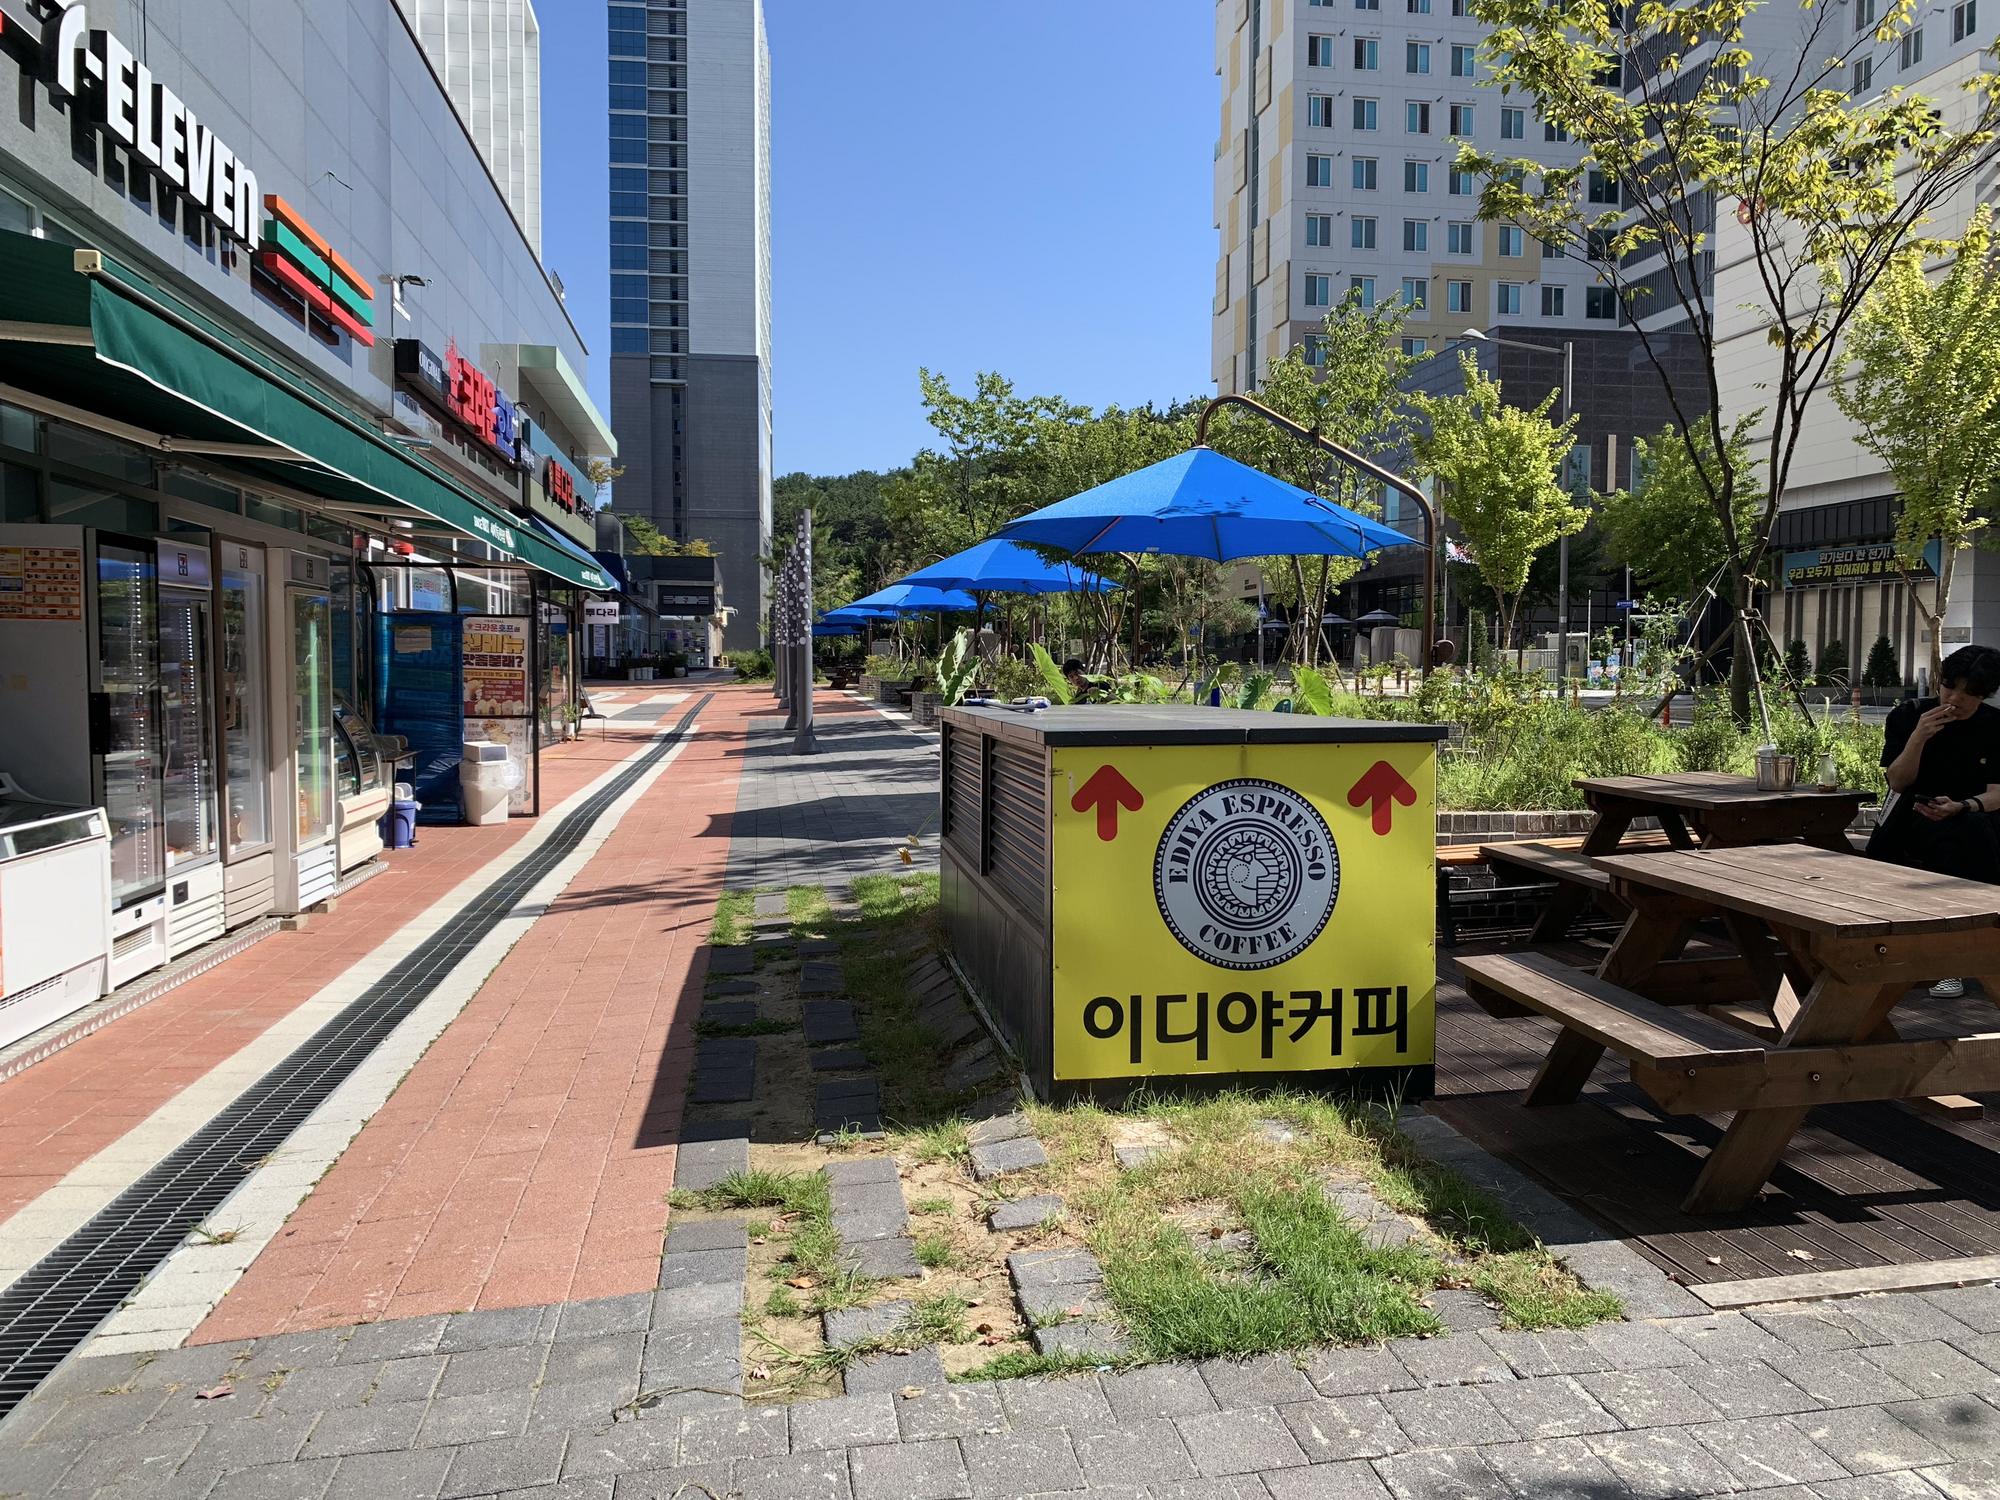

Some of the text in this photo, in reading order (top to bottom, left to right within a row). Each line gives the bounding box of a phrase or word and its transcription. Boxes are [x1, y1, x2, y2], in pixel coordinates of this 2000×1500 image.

[1788, 568, 1804, 580] 우리
[1806, 566, 1832, 578] 모두가
[585, 608, 617, 617] 투다리
[1169, 793, 1327, 884] EDIYA ESPRESSO
[1199, 921, 1297, 955] COFFEE
[1083, 985, 1408, 1064] 이디야커피
